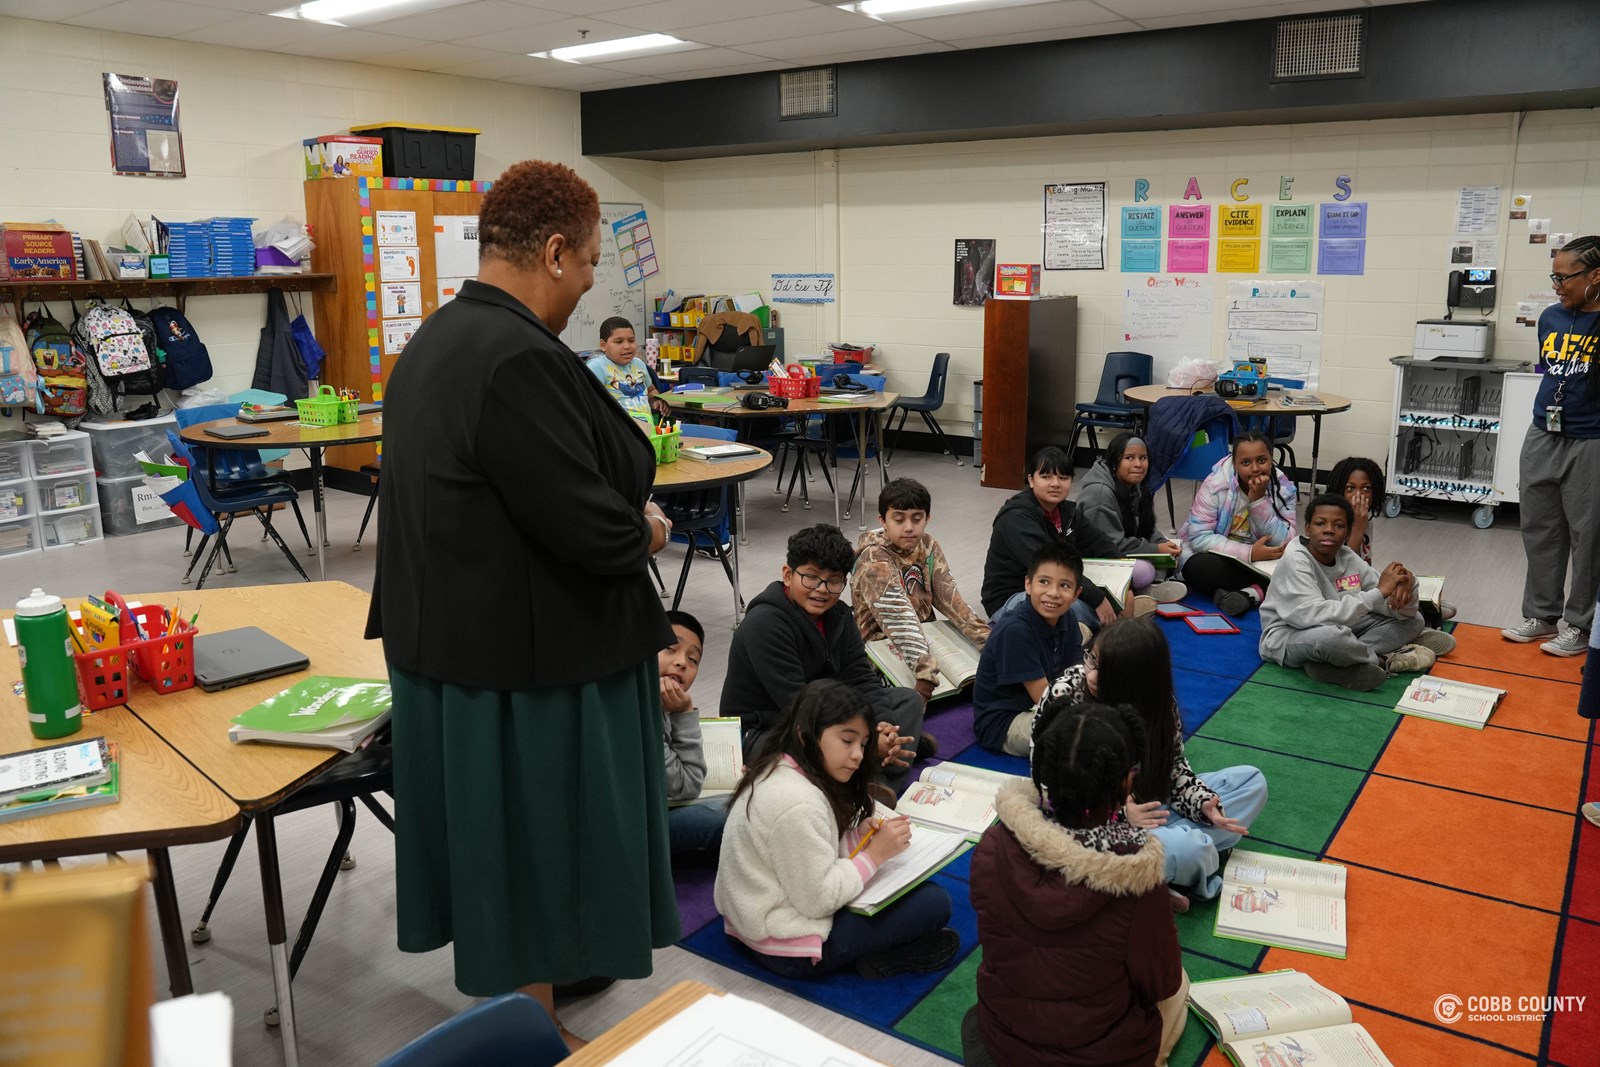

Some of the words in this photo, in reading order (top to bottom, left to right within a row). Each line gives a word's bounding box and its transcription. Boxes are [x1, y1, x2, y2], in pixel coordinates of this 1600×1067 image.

[1134, 178, 1150, 202] R
[1184, 176, 1202, 200] A
[1230, 178, 1250, 202] C
[1279, 176, 1295, 200] E
[1333, 174, 1352, 202] S
[1128, 212, 1155, 220] RESTATE
[1230, 210, 1249, 219] CITE
[1276, 209, 1307, 217] EXPLAIN
[14, 258, 34, 266] Early
[1147, 276, 1172, 287] Opinion
[773, 280, 792, 291] Dd
[795, 280, 810, 291] Ee
[814, 280, 833, 296] Ff
[1252, 288, 1270, 298] Parts
[1244, 301, 1281, 309] Introduction
[1236, 332, 1260, 340] Reasons
